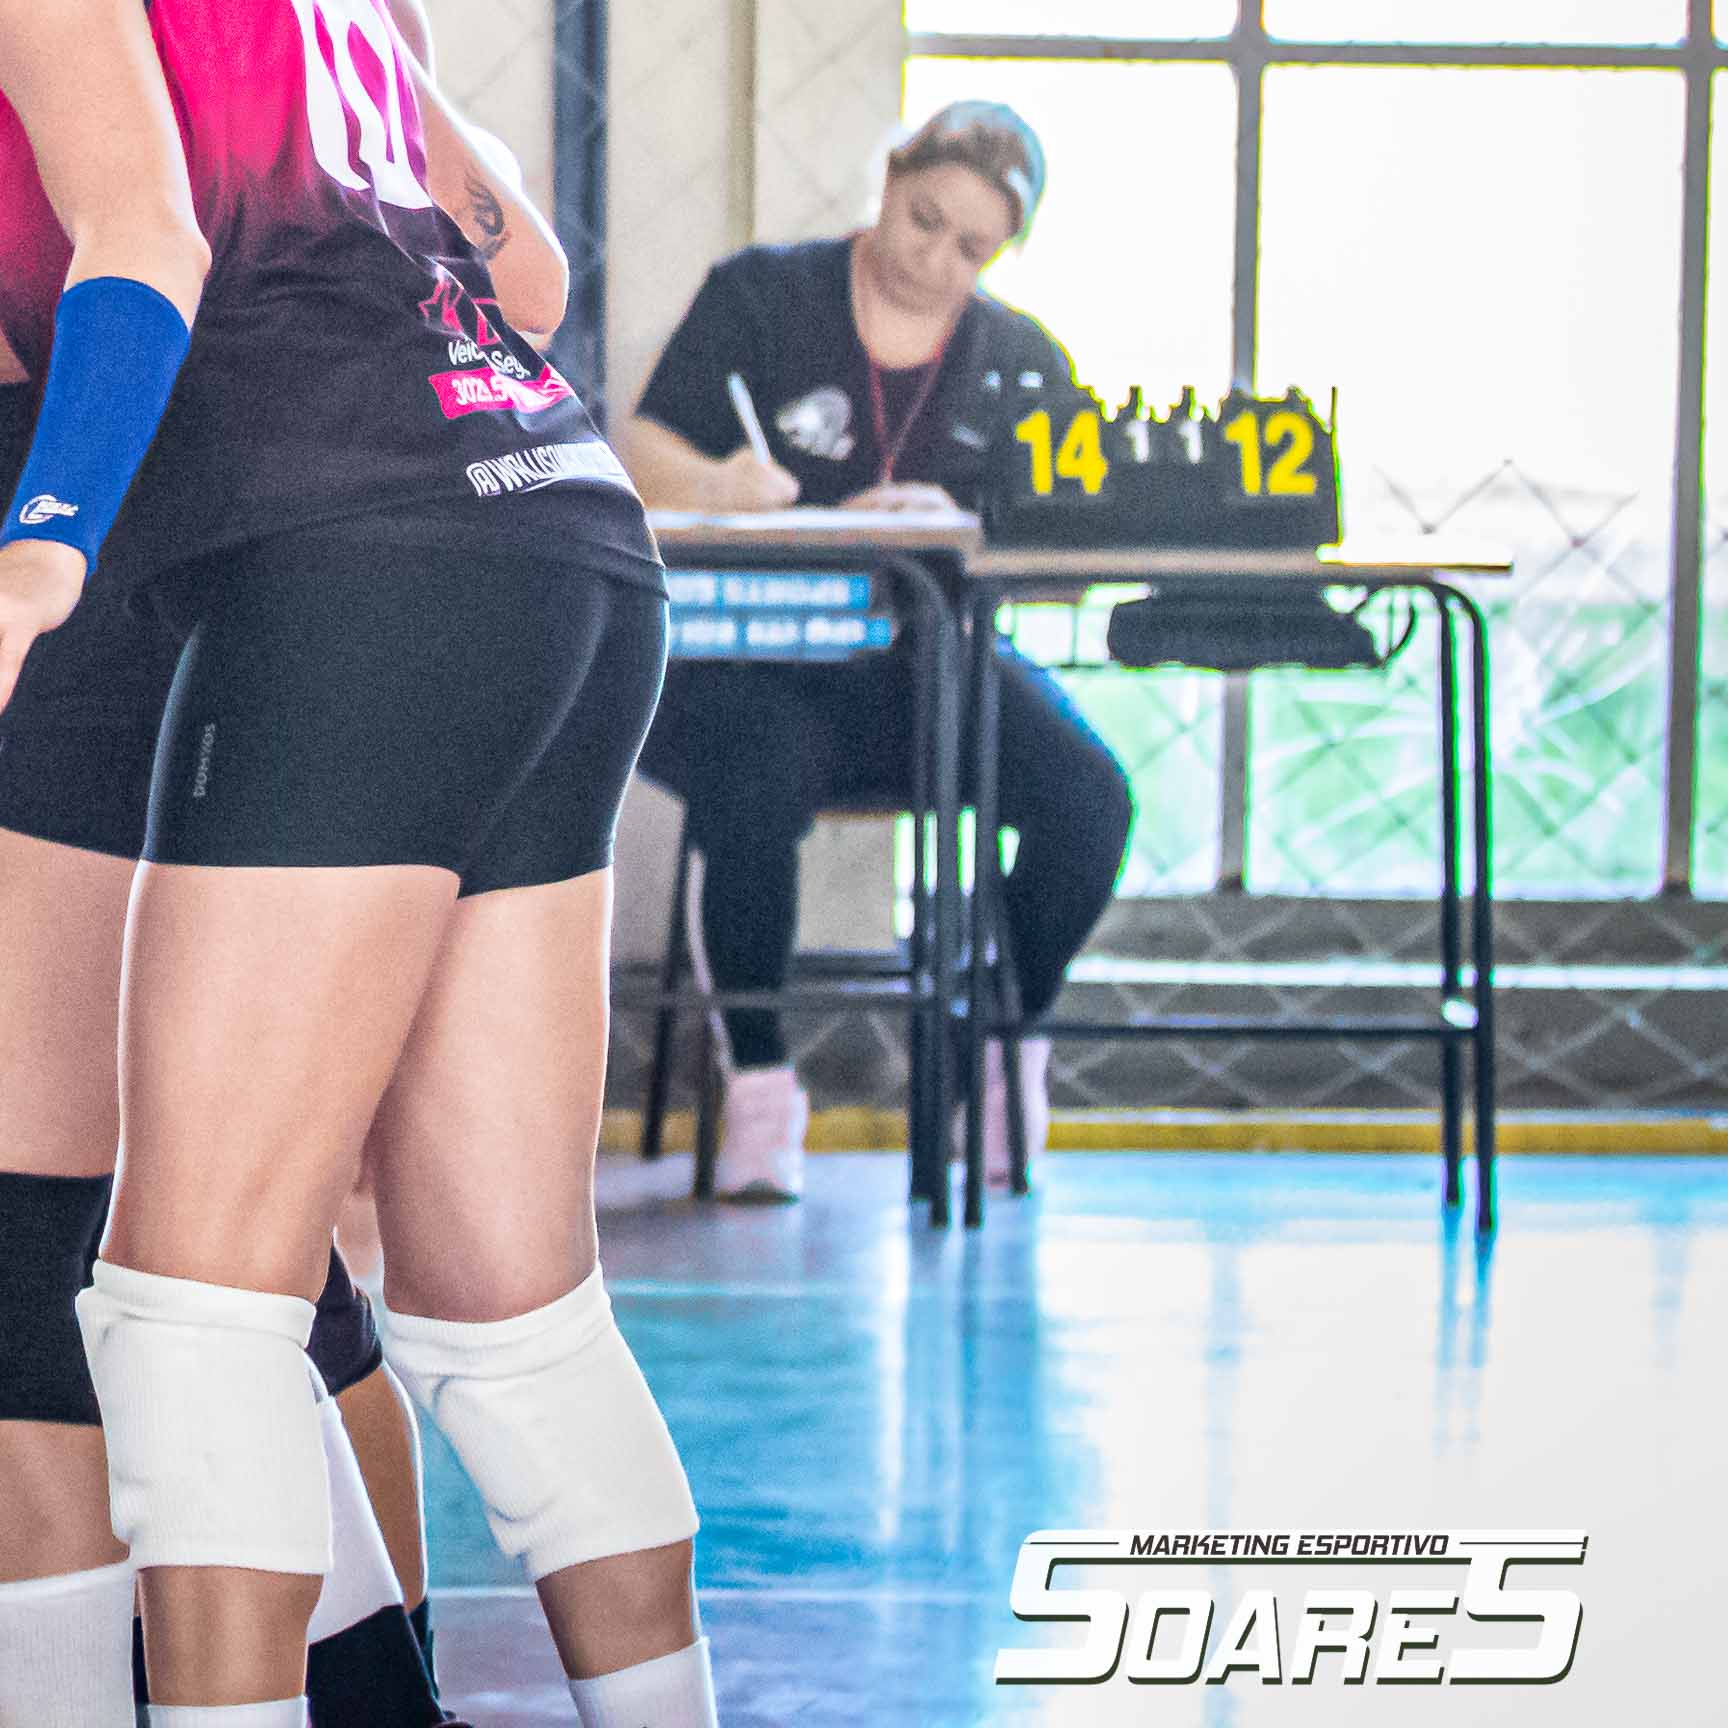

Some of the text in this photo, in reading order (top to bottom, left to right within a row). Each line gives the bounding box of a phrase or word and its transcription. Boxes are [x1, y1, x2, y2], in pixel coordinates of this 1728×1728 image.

[1016, 410, 1108, 496] 14
[1126, 418, 1150, 464] 1
[1180, 418, 1203, 464] 1
[1225, 410, 1318, 496] 12
